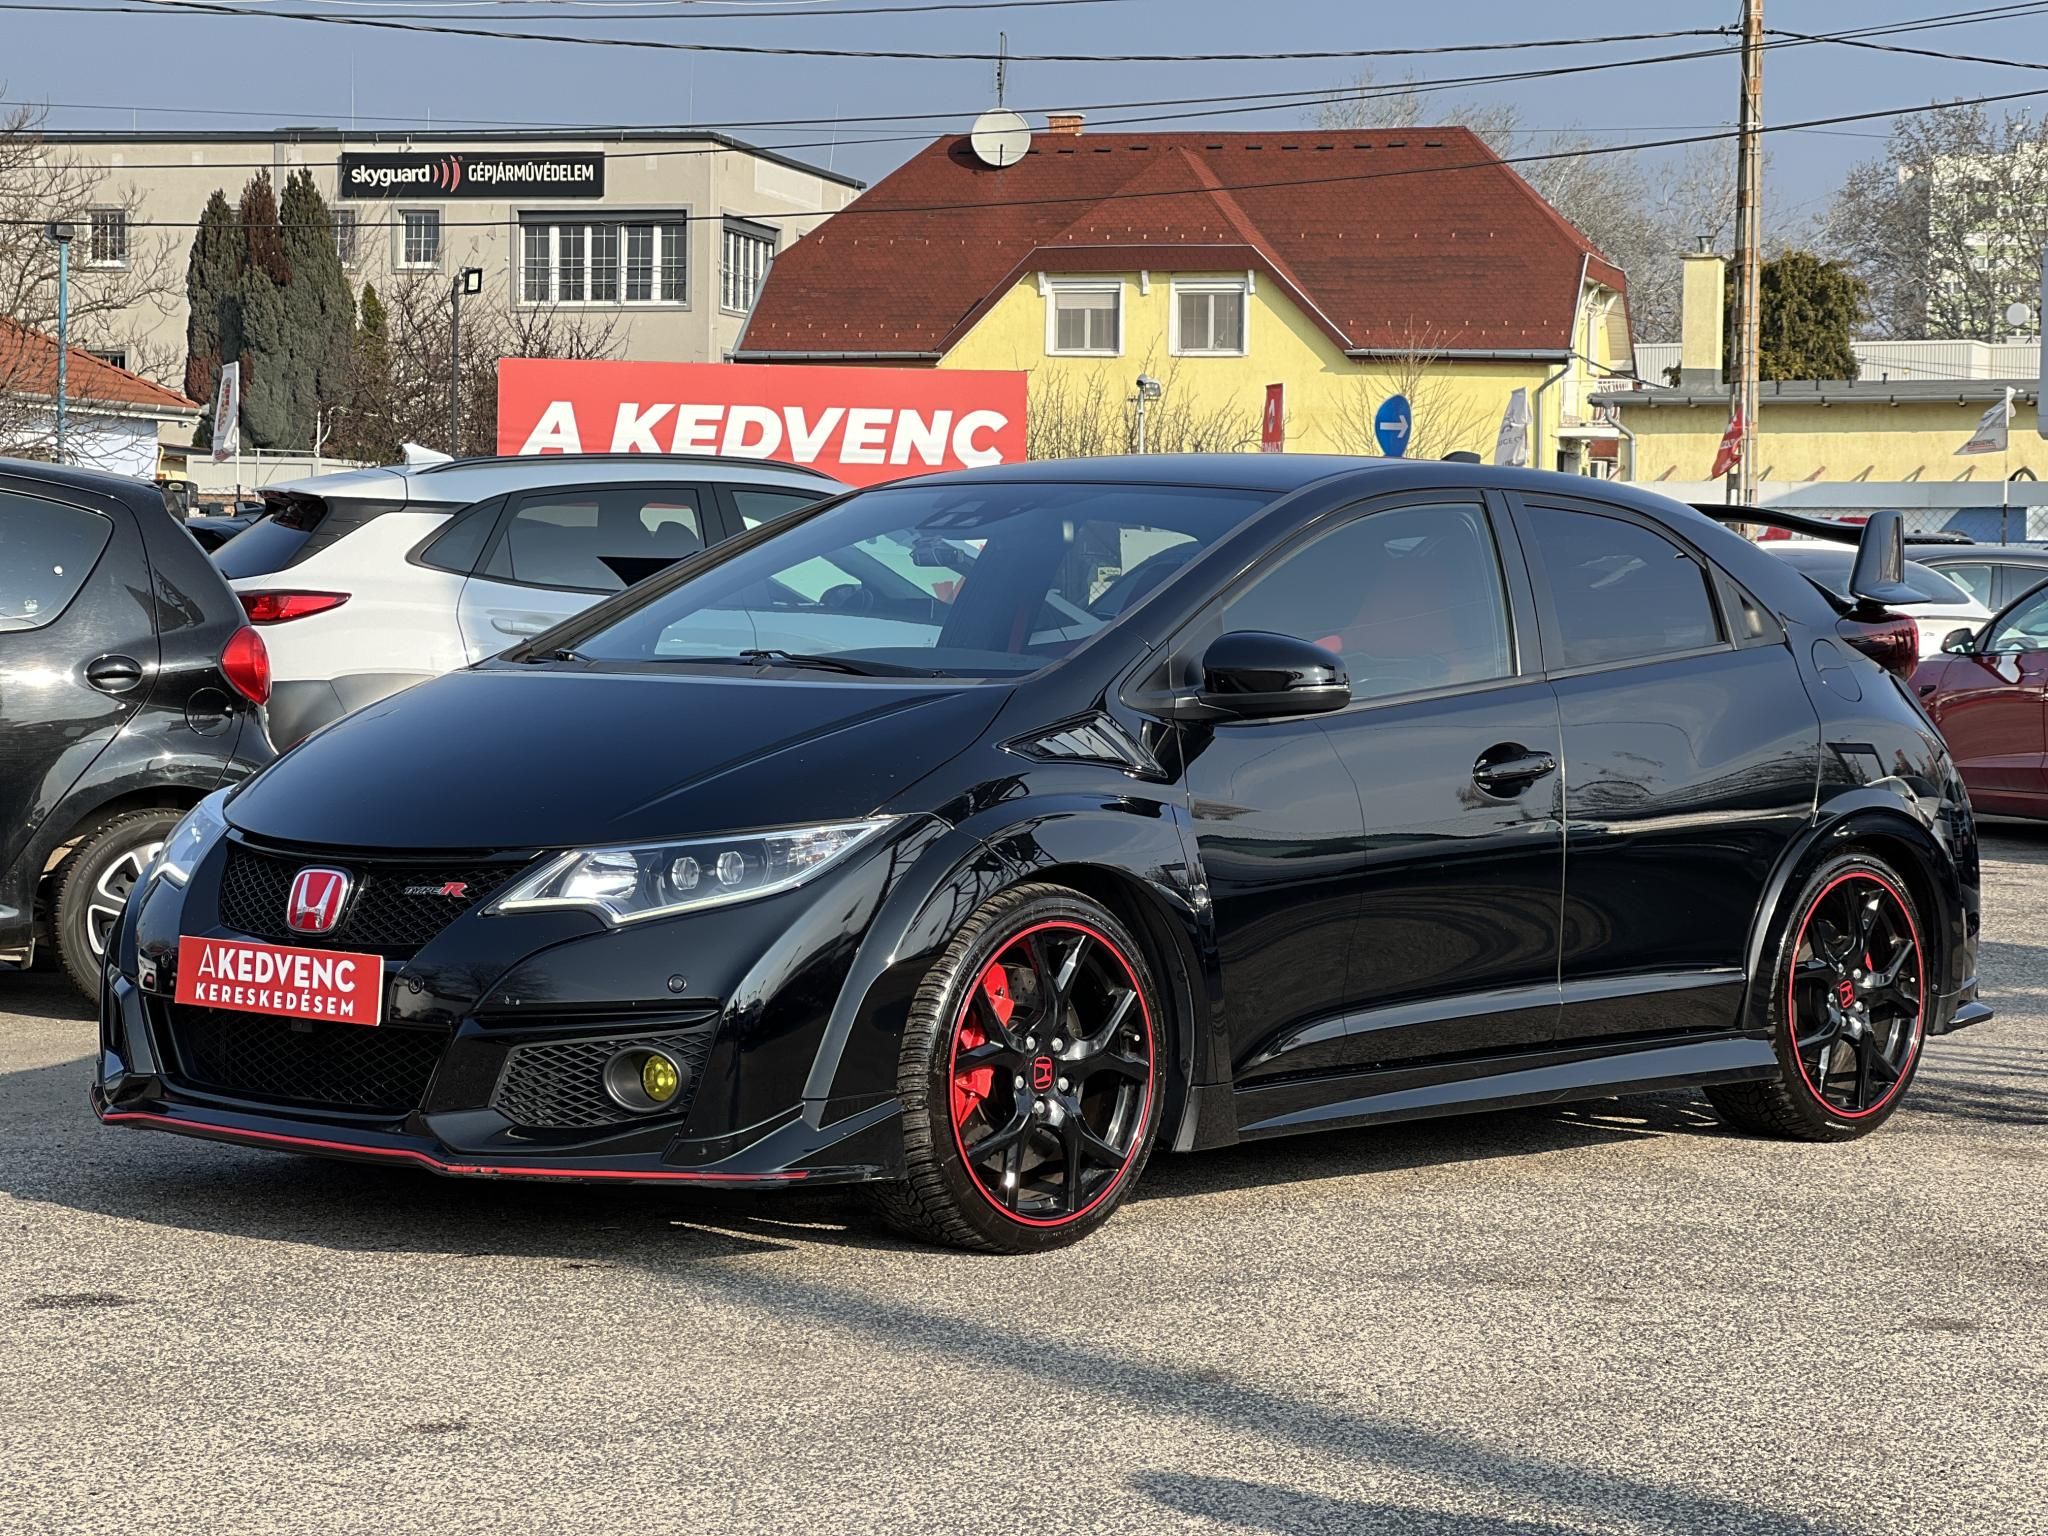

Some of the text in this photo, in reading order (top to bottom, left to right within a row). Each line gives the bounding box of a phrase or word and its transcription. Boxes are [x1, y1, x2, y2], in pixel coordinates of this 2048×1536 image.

[351, 160, 594, 187] skyguard GÉPJÁRMŰVÉDELEM
[518, 400, 1009, 469] A KEDVENC
[195, 982, 354, 1017] KERESKEDÉSEM
